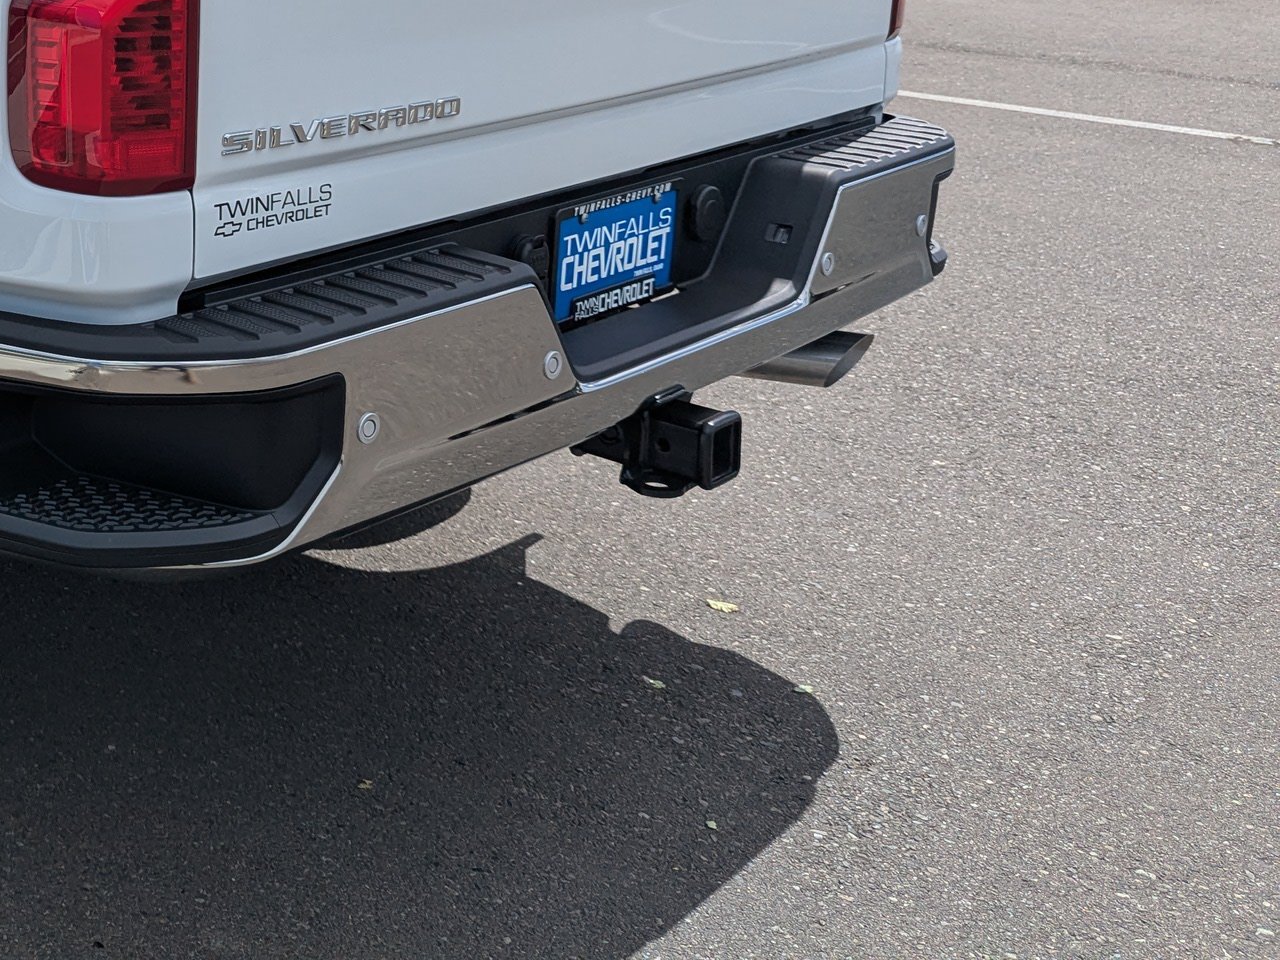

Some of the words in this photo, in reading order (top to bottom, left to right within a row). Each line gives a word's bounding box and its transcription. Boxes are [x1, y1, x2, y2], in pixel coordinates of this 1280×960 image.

[220, 96, 461, 156] SILVERADO
[214, 183, 332, 221] TWINFALLS
[246, 203, 332, 231] CHEVROLET
[574, 182, 673, 217] TWINFALLS-CHEVY.COM
[563, 207, 673, 256] TWINFALLS
[560, 227, 671, 292] CHEVROLET
[574, 305, 599, 322] FALLS
[575, 296, 600, 313] TWIN
[598, 278, 656, 313] CHEVROLET
